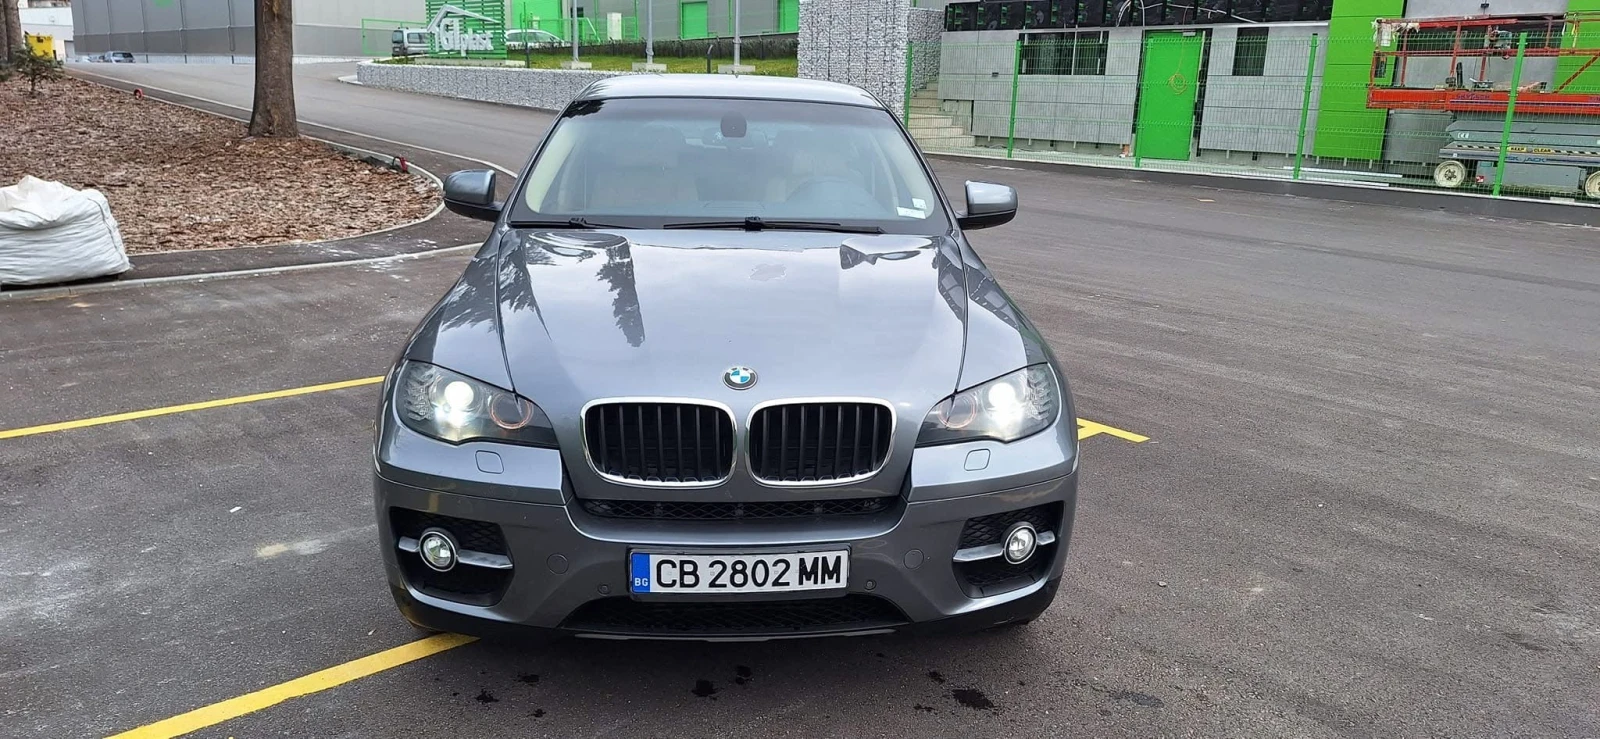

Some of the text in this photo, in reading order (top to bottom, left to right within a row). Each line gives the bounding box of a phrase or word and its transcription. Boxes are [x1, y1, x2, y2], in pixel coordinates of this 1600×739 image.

[634, 555, 842, 588] BG CB 2802 MM
